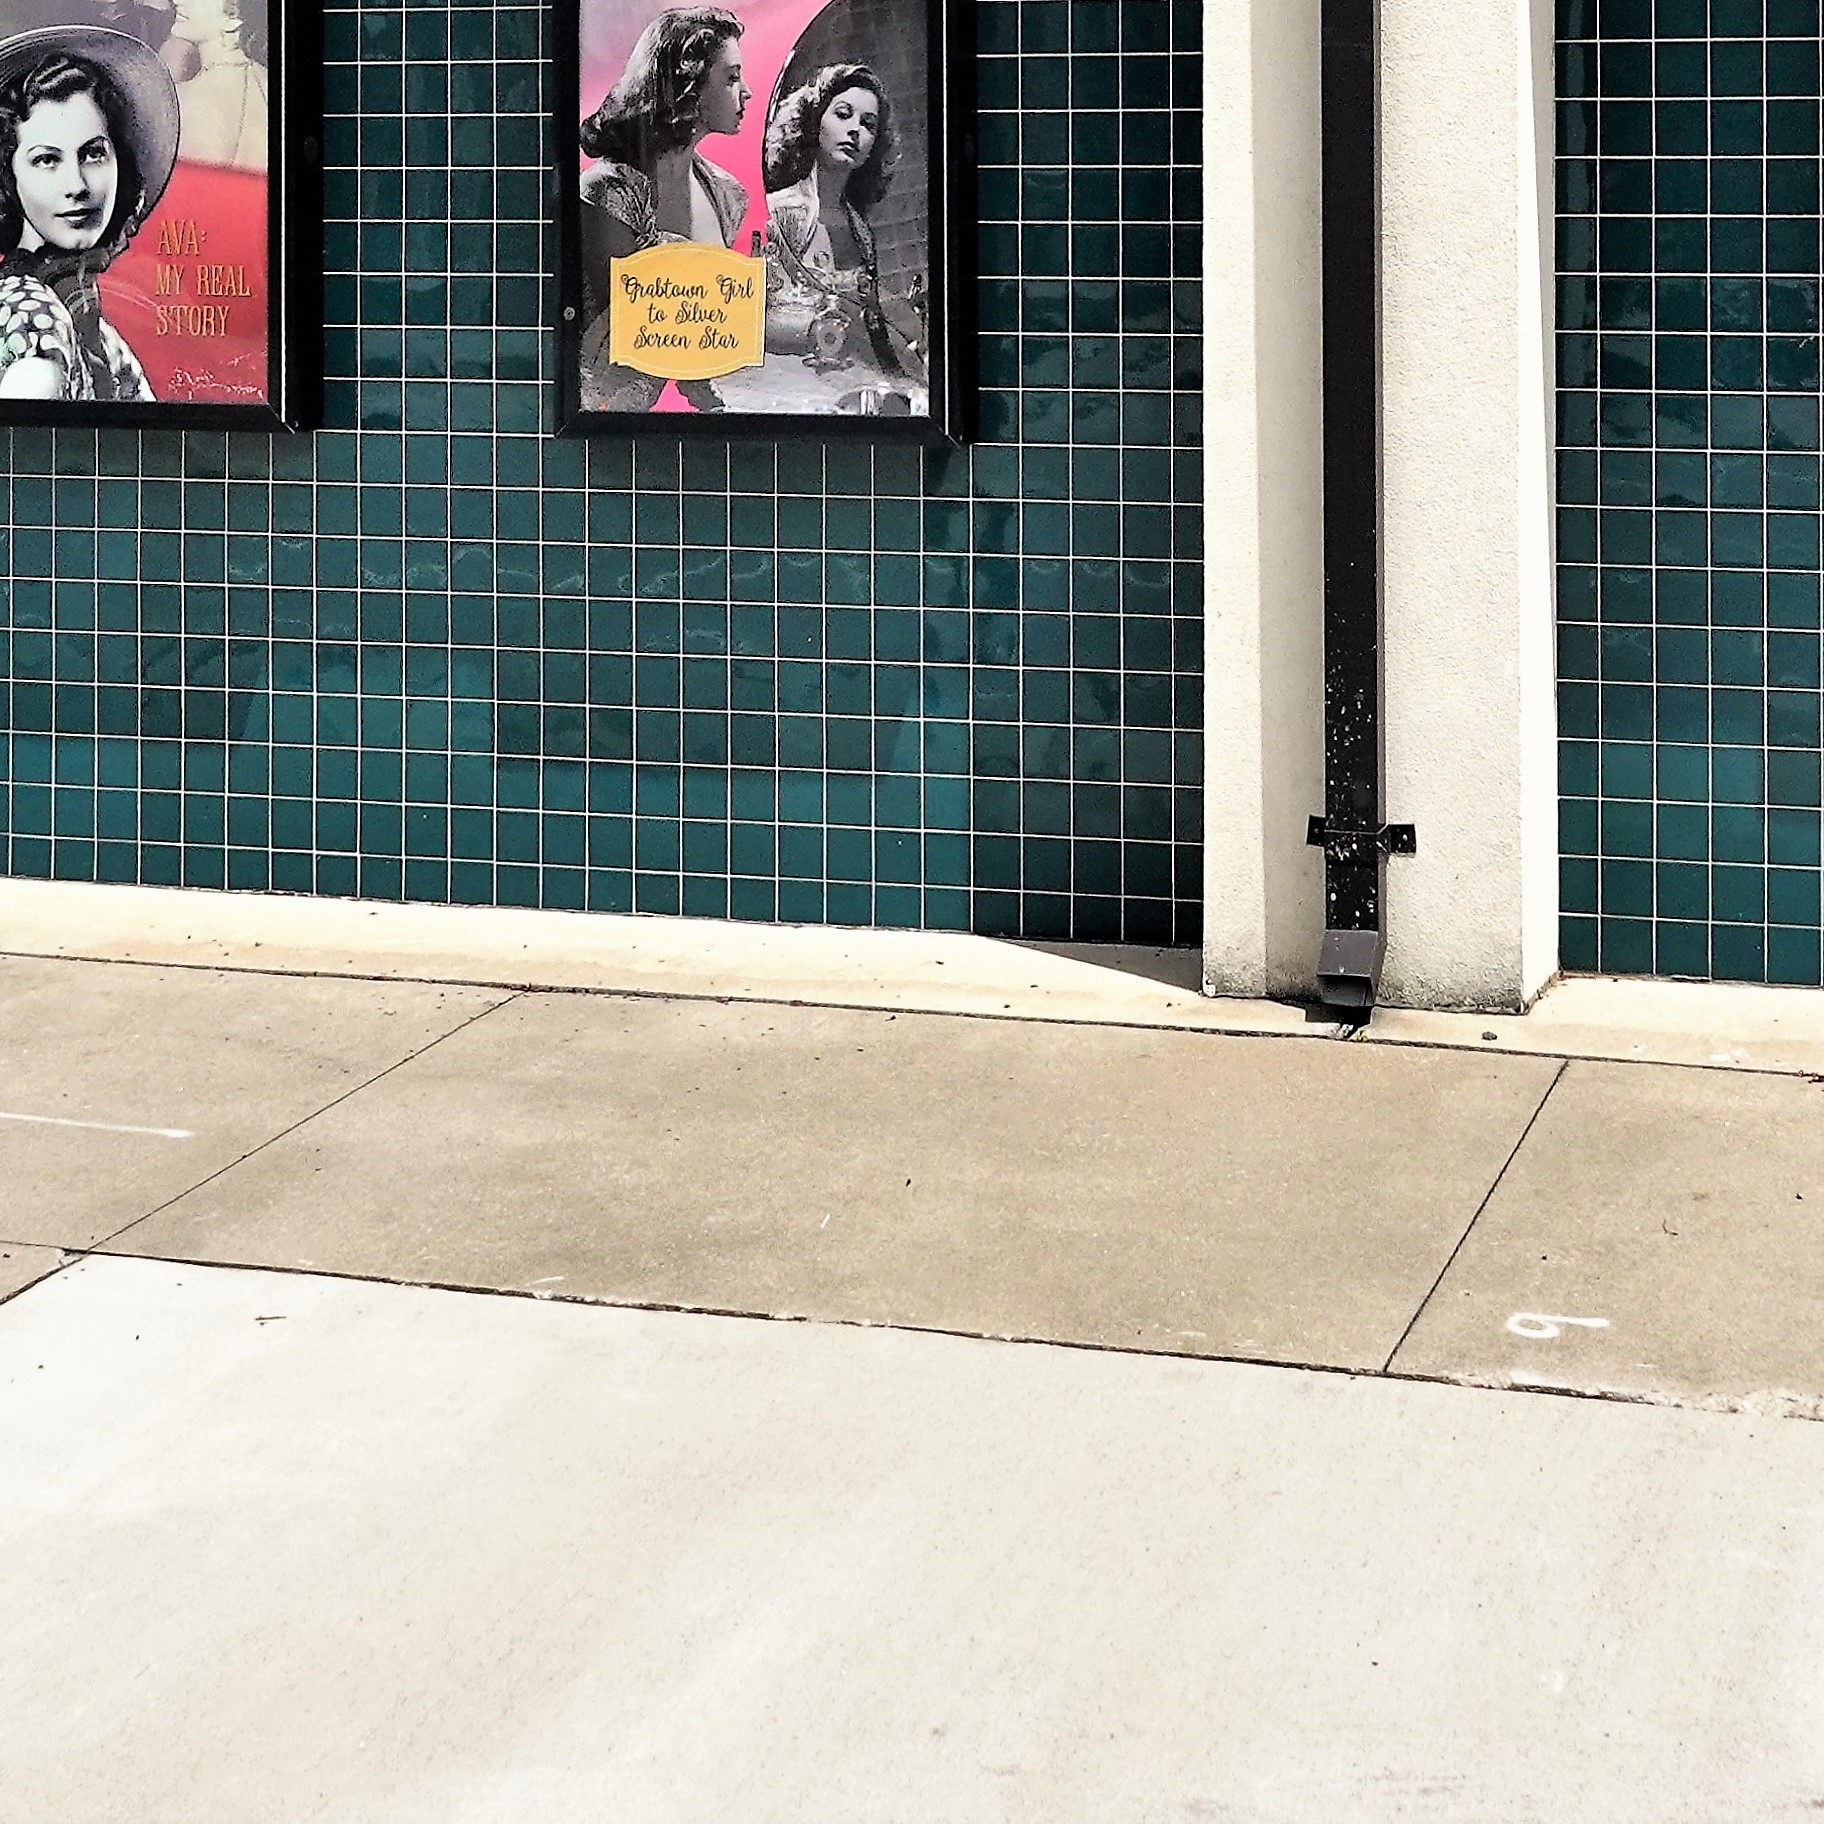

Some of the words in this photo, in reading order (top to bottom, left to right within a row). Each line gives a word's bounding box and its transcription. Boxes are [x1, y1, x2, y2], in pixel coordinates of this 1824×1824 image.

[156, 219, 207, 256] AVA:
[155, 263, 184, 297] MY
[196, 264, 252, 297] REAL
[620, 273, 708, 304] Grabtown
[715, 273, 755, 305] Girl
[155, 304, 230, 337] STORY
[646, 302, 668, 324] to
[674, 300, 728, 325] Silver
[633, 324, 692, 350] Screen
[698, 325, 739, 350] Star
